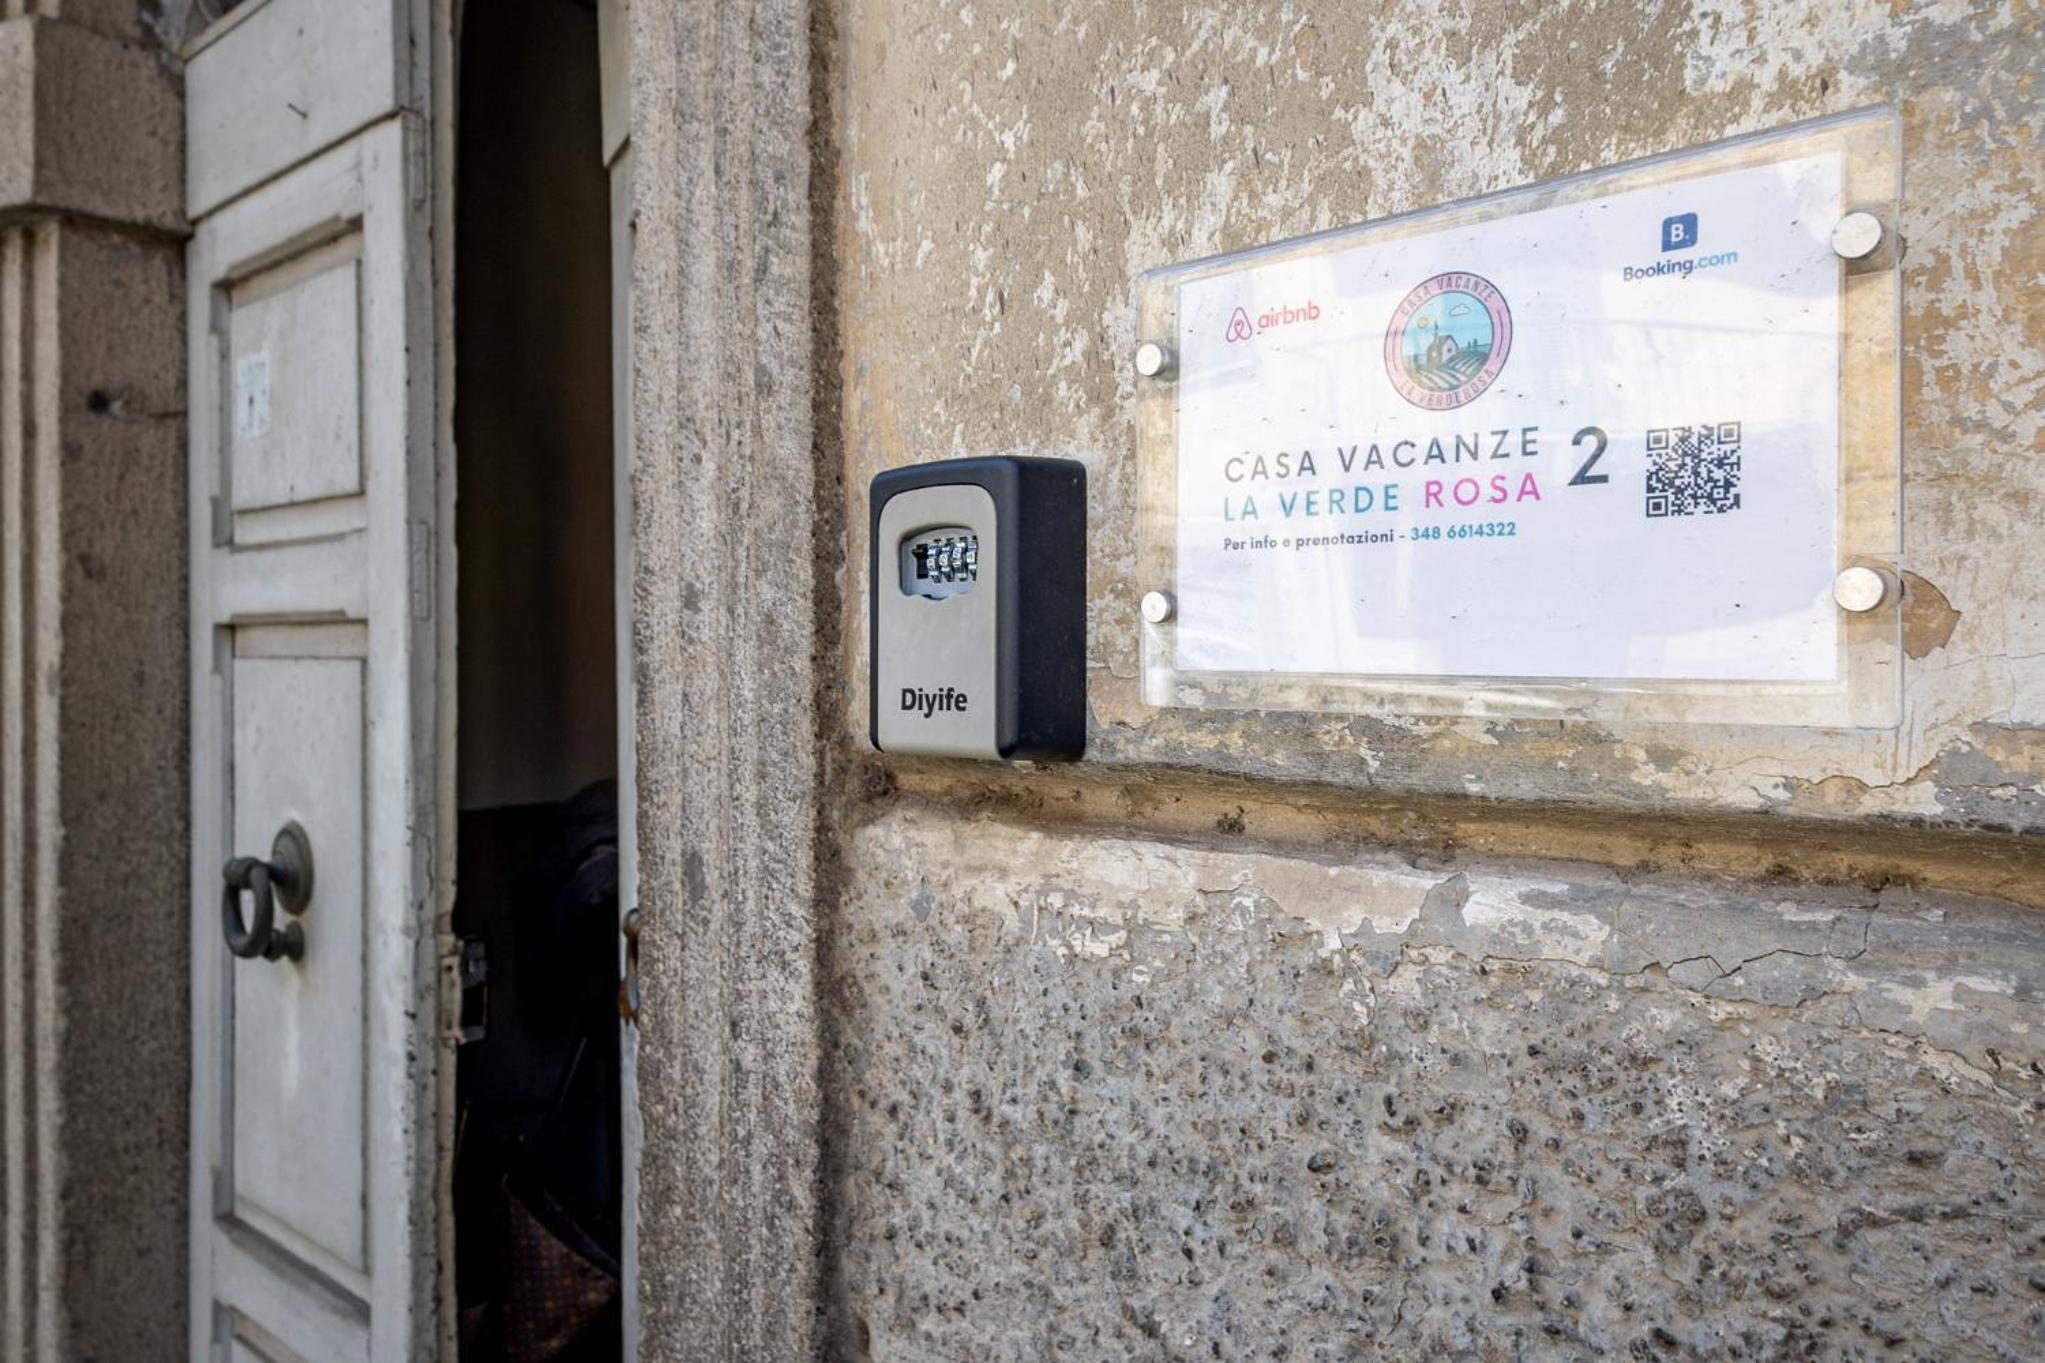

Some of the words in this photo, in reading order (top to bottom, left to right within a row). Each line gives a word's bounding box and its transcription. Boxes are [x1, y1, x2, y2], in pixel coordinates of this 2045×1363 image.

[1623, 251, 1738, 281] Booking.com
[1258, 300, 1320, 329] airbnb
[1401, 284, 1431, 317] CASA
[1437, 275, 1497, 302] VACANZE
[1224, 450, 1317, 483] CASA
[1337, 426, 1540, 473] VACANZE
[1568, 426, 1610, 486] 2
[1224, 496, 1259, 522] LA
[1279, 484, 1400, 518] VERDE
[1424, 472, 1541, 509] ROSA
[1224, 538, 1246, 551] Per
[1250, 535, 1277, 549] info
[1296, 529, 1394, 551] prenotazioni
[1411, 526, 1441, 541] 348
[1447, 521, 1516, 539] 6614322
[901, 687, 968, 719] Diyife
